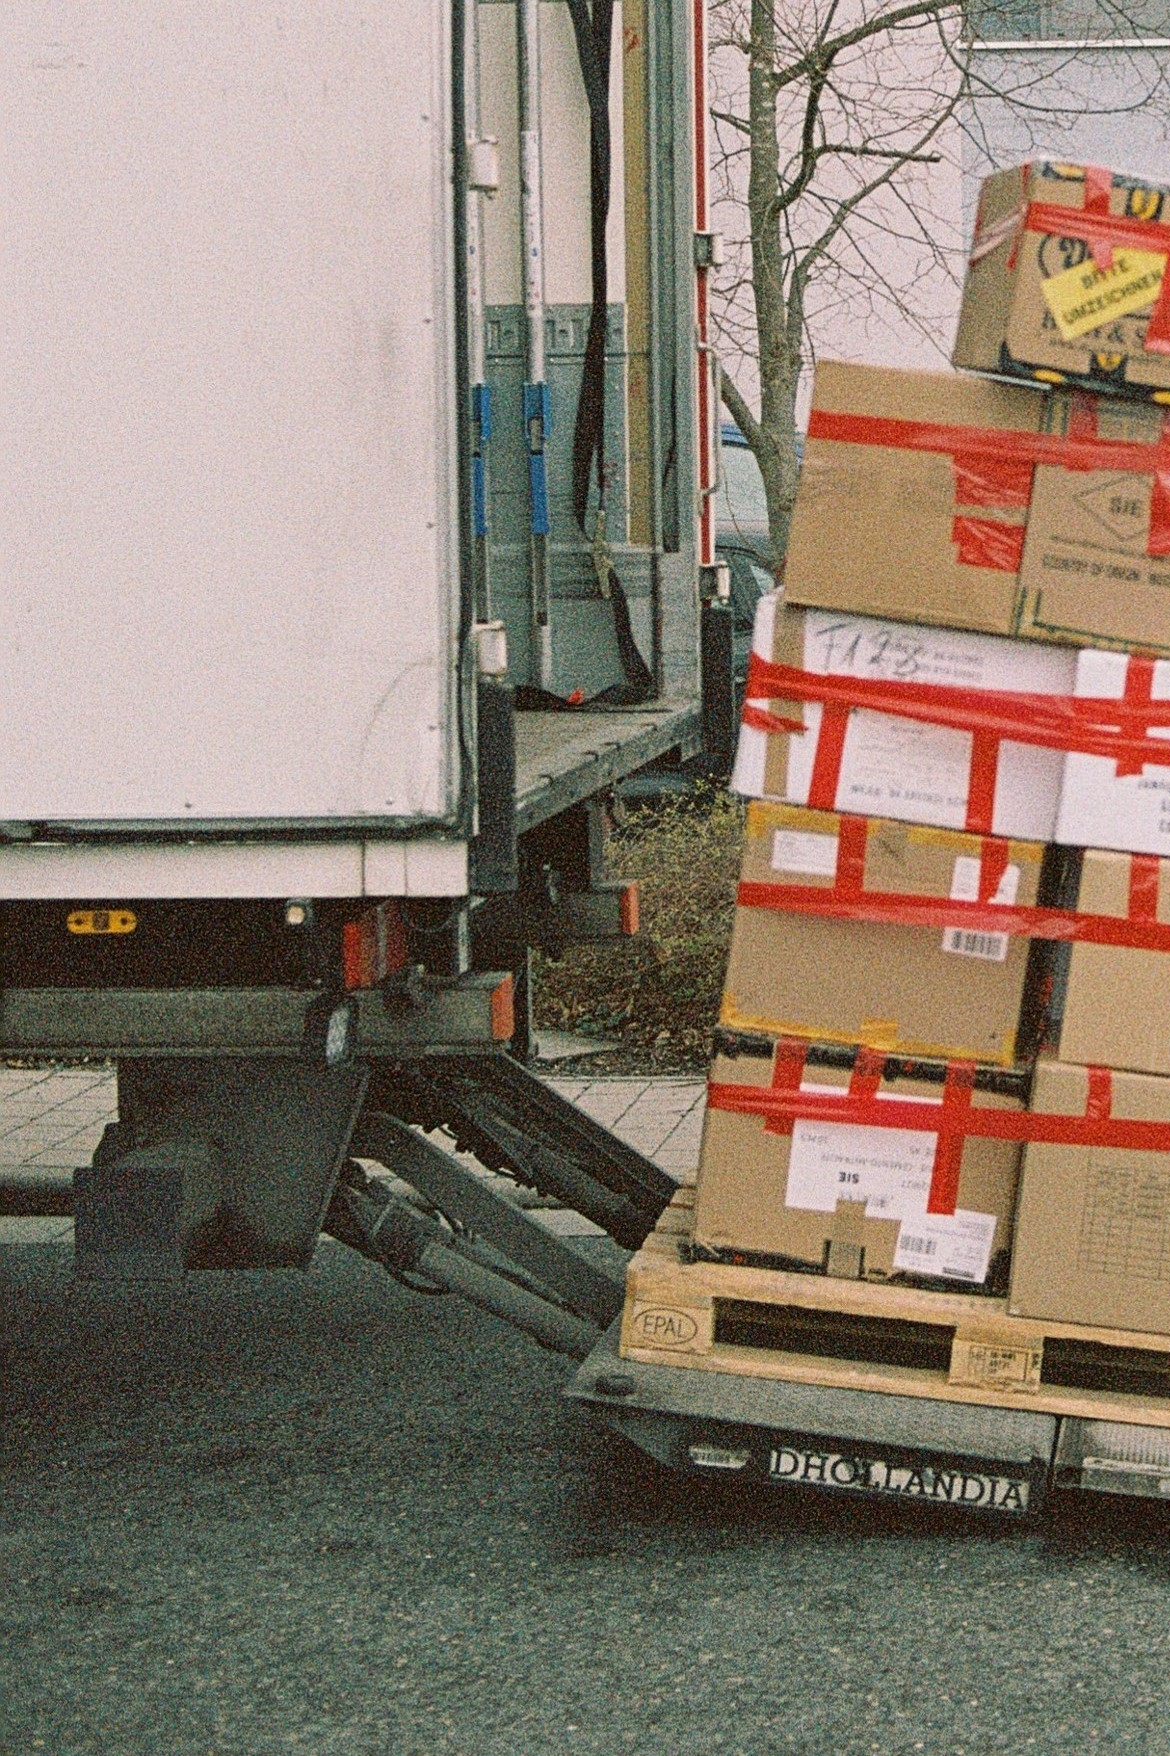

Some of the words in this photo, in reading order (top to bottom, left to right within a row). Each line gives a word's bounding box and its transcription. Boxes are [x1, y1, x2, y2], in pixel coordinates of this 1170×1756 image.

[838, 1171, 859, 1183] SIE
[642, 1313, 687, 1338] EPAL
[770, 1449, 1025, 1509] DHOLLANDIA
